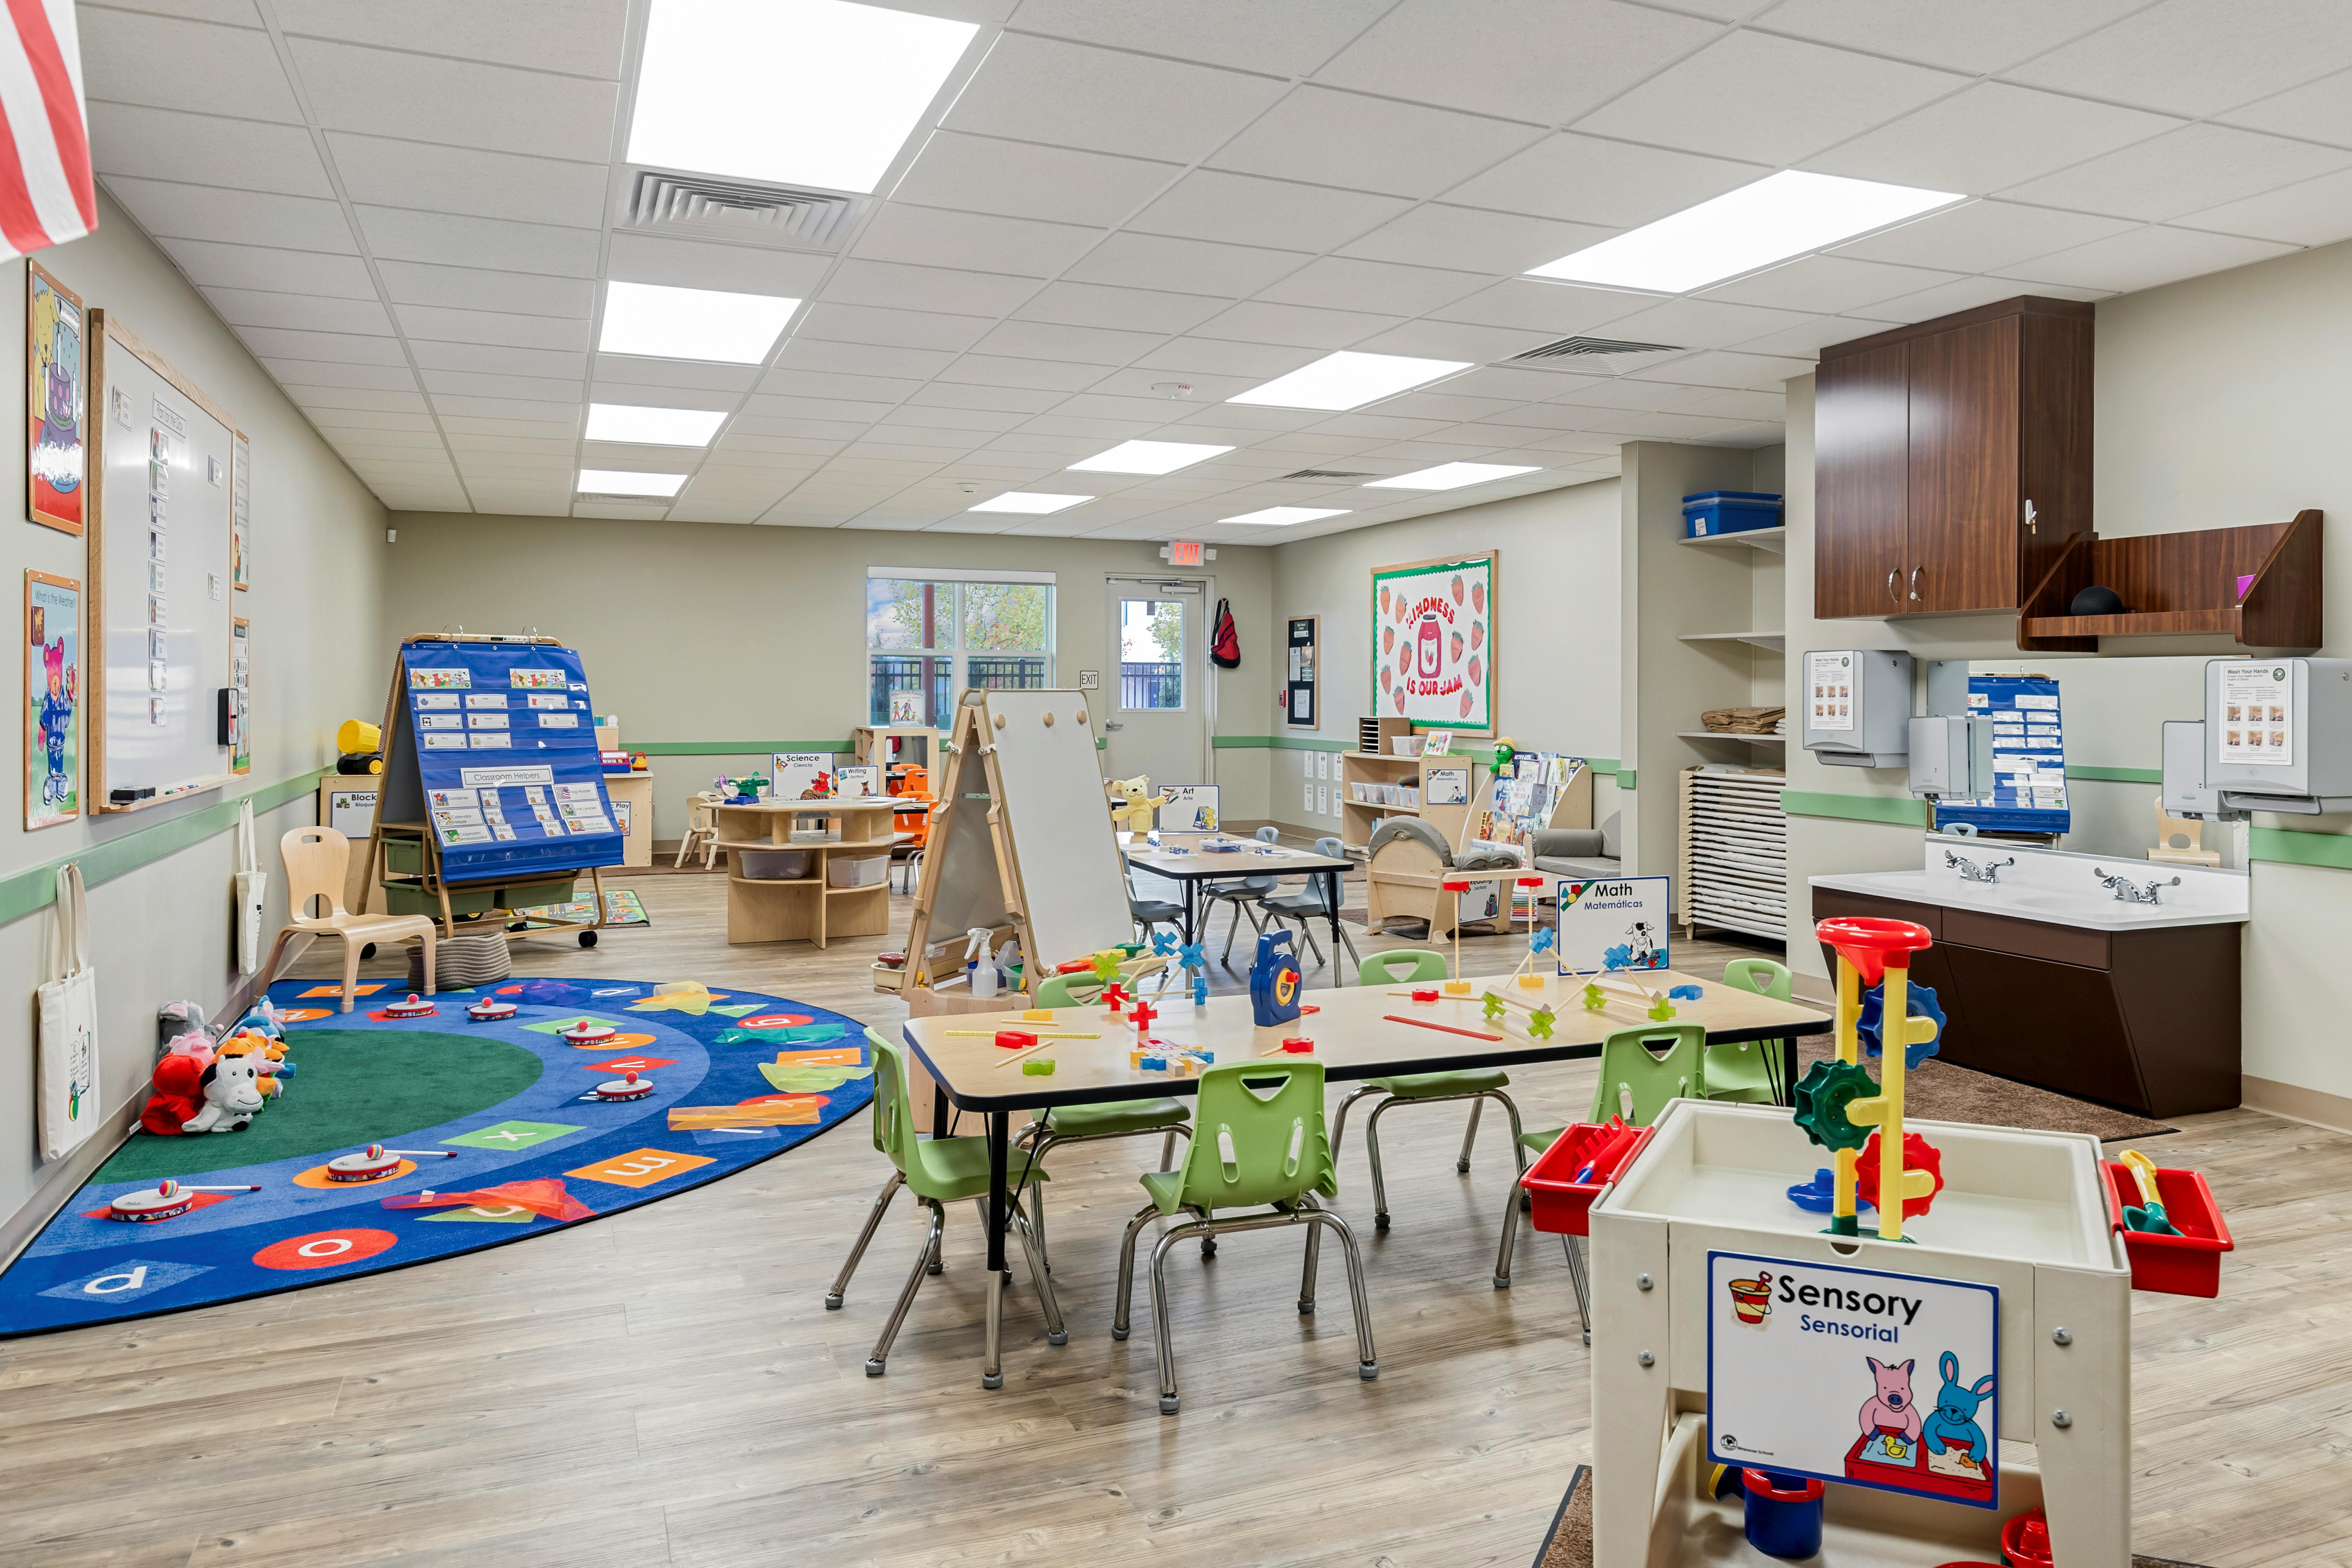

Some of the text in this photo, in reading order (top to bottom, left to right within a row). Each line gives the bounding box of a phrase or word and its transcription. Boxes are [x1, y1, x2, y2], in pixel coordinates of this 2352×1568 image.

[1175, 543, 1200, 564] EXIT
[35, 589, 47, 603] What
[47, 591, 50, 603] is
[58, 594, 76, 608] Weather?
[1406, 596, 1455, 629] KINDNESS
[1081, 674, 1097, 685] EXIT
[1406, 674, 1463, 696] IS OUR JAM
[513, 772, 540, 780] Helpers
[1594, 883, 1632, 897] Math
[1584, 899, 1643, 910] Matemáticas
[1778, 1274, 1923, 1325] Sensory
[1800, 1314, 1899, 1344] Sensorial
